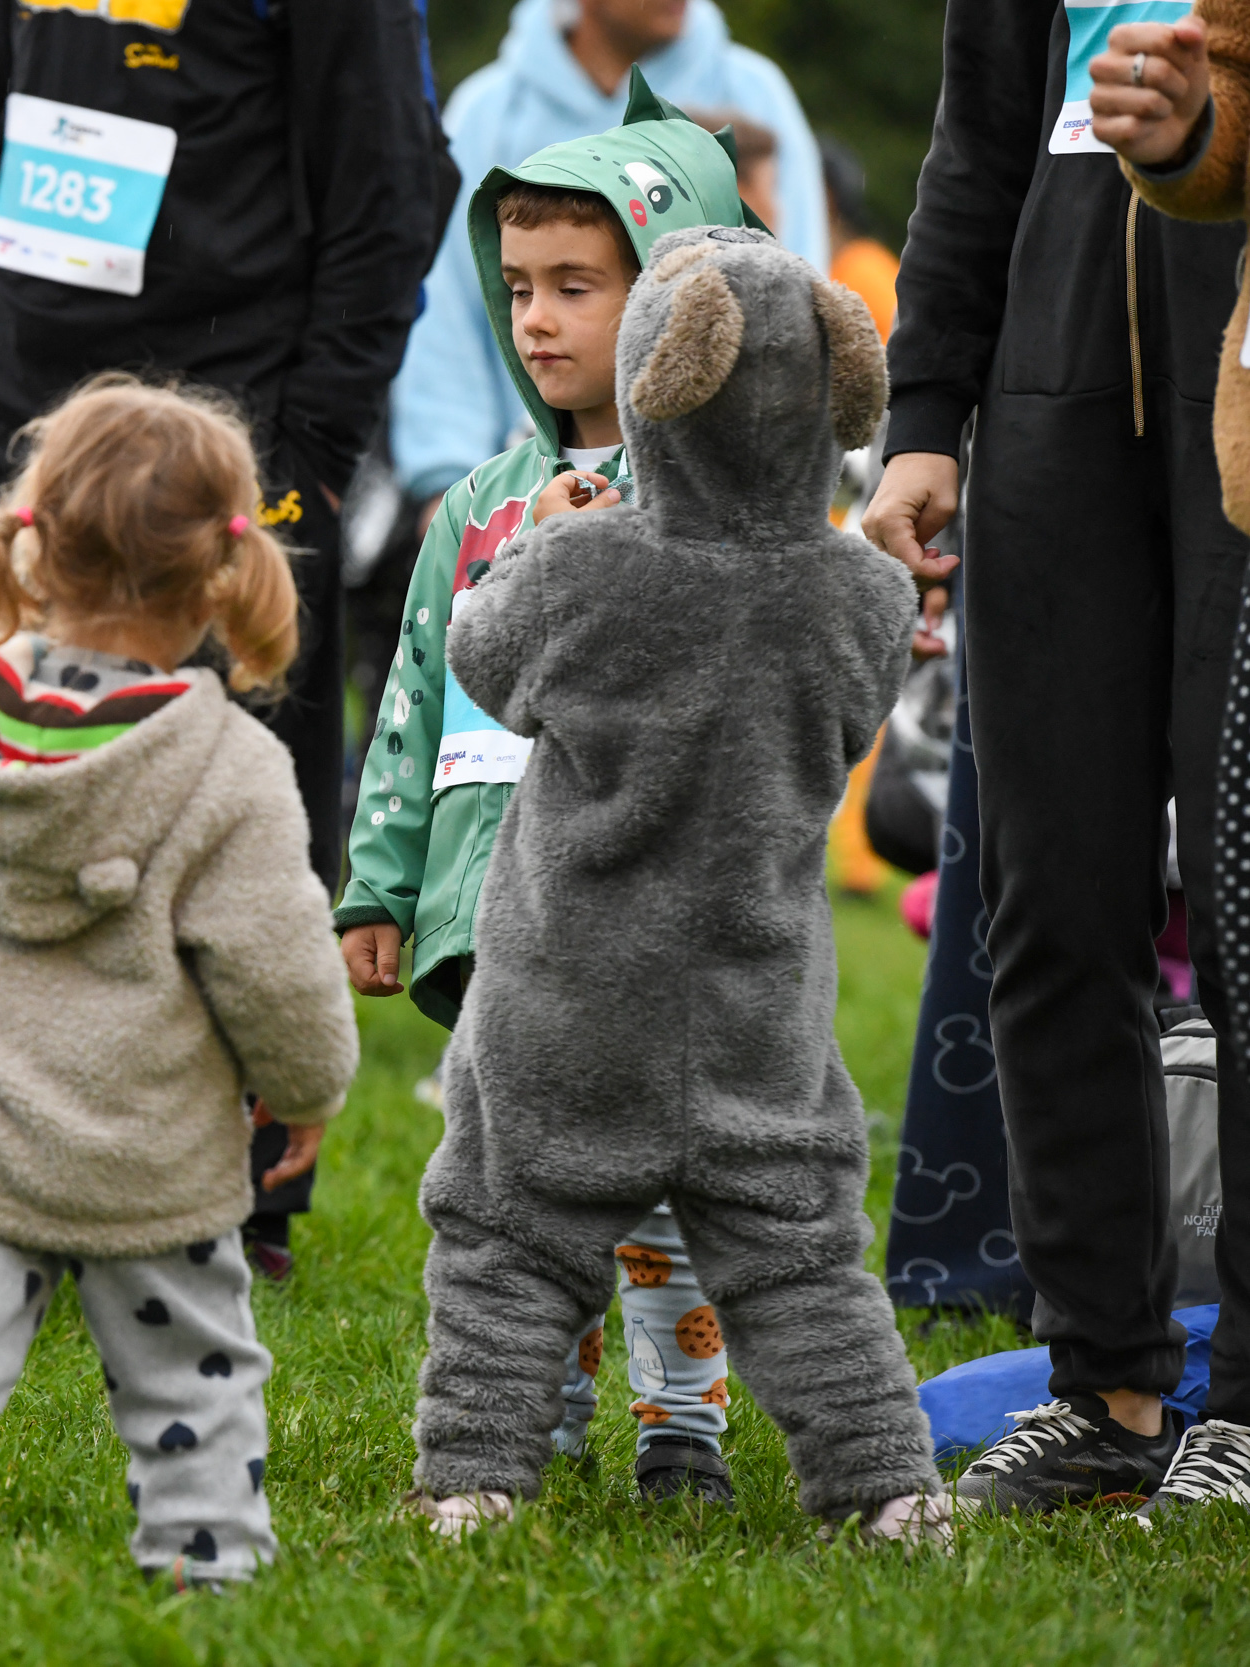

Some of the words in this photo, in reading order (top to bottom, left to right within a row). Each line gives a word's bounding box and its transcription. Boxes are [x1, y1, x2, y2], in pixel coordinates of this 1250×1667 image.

[20, 160, 117, 224] 1283
[439, 750, 467, 764] ESSELUNGA
[1183, 1215, 1219, 1226] NORT
[1196, 1226, 1217, 1237] FAC
[635, 1357, 660, 1370] MILK
